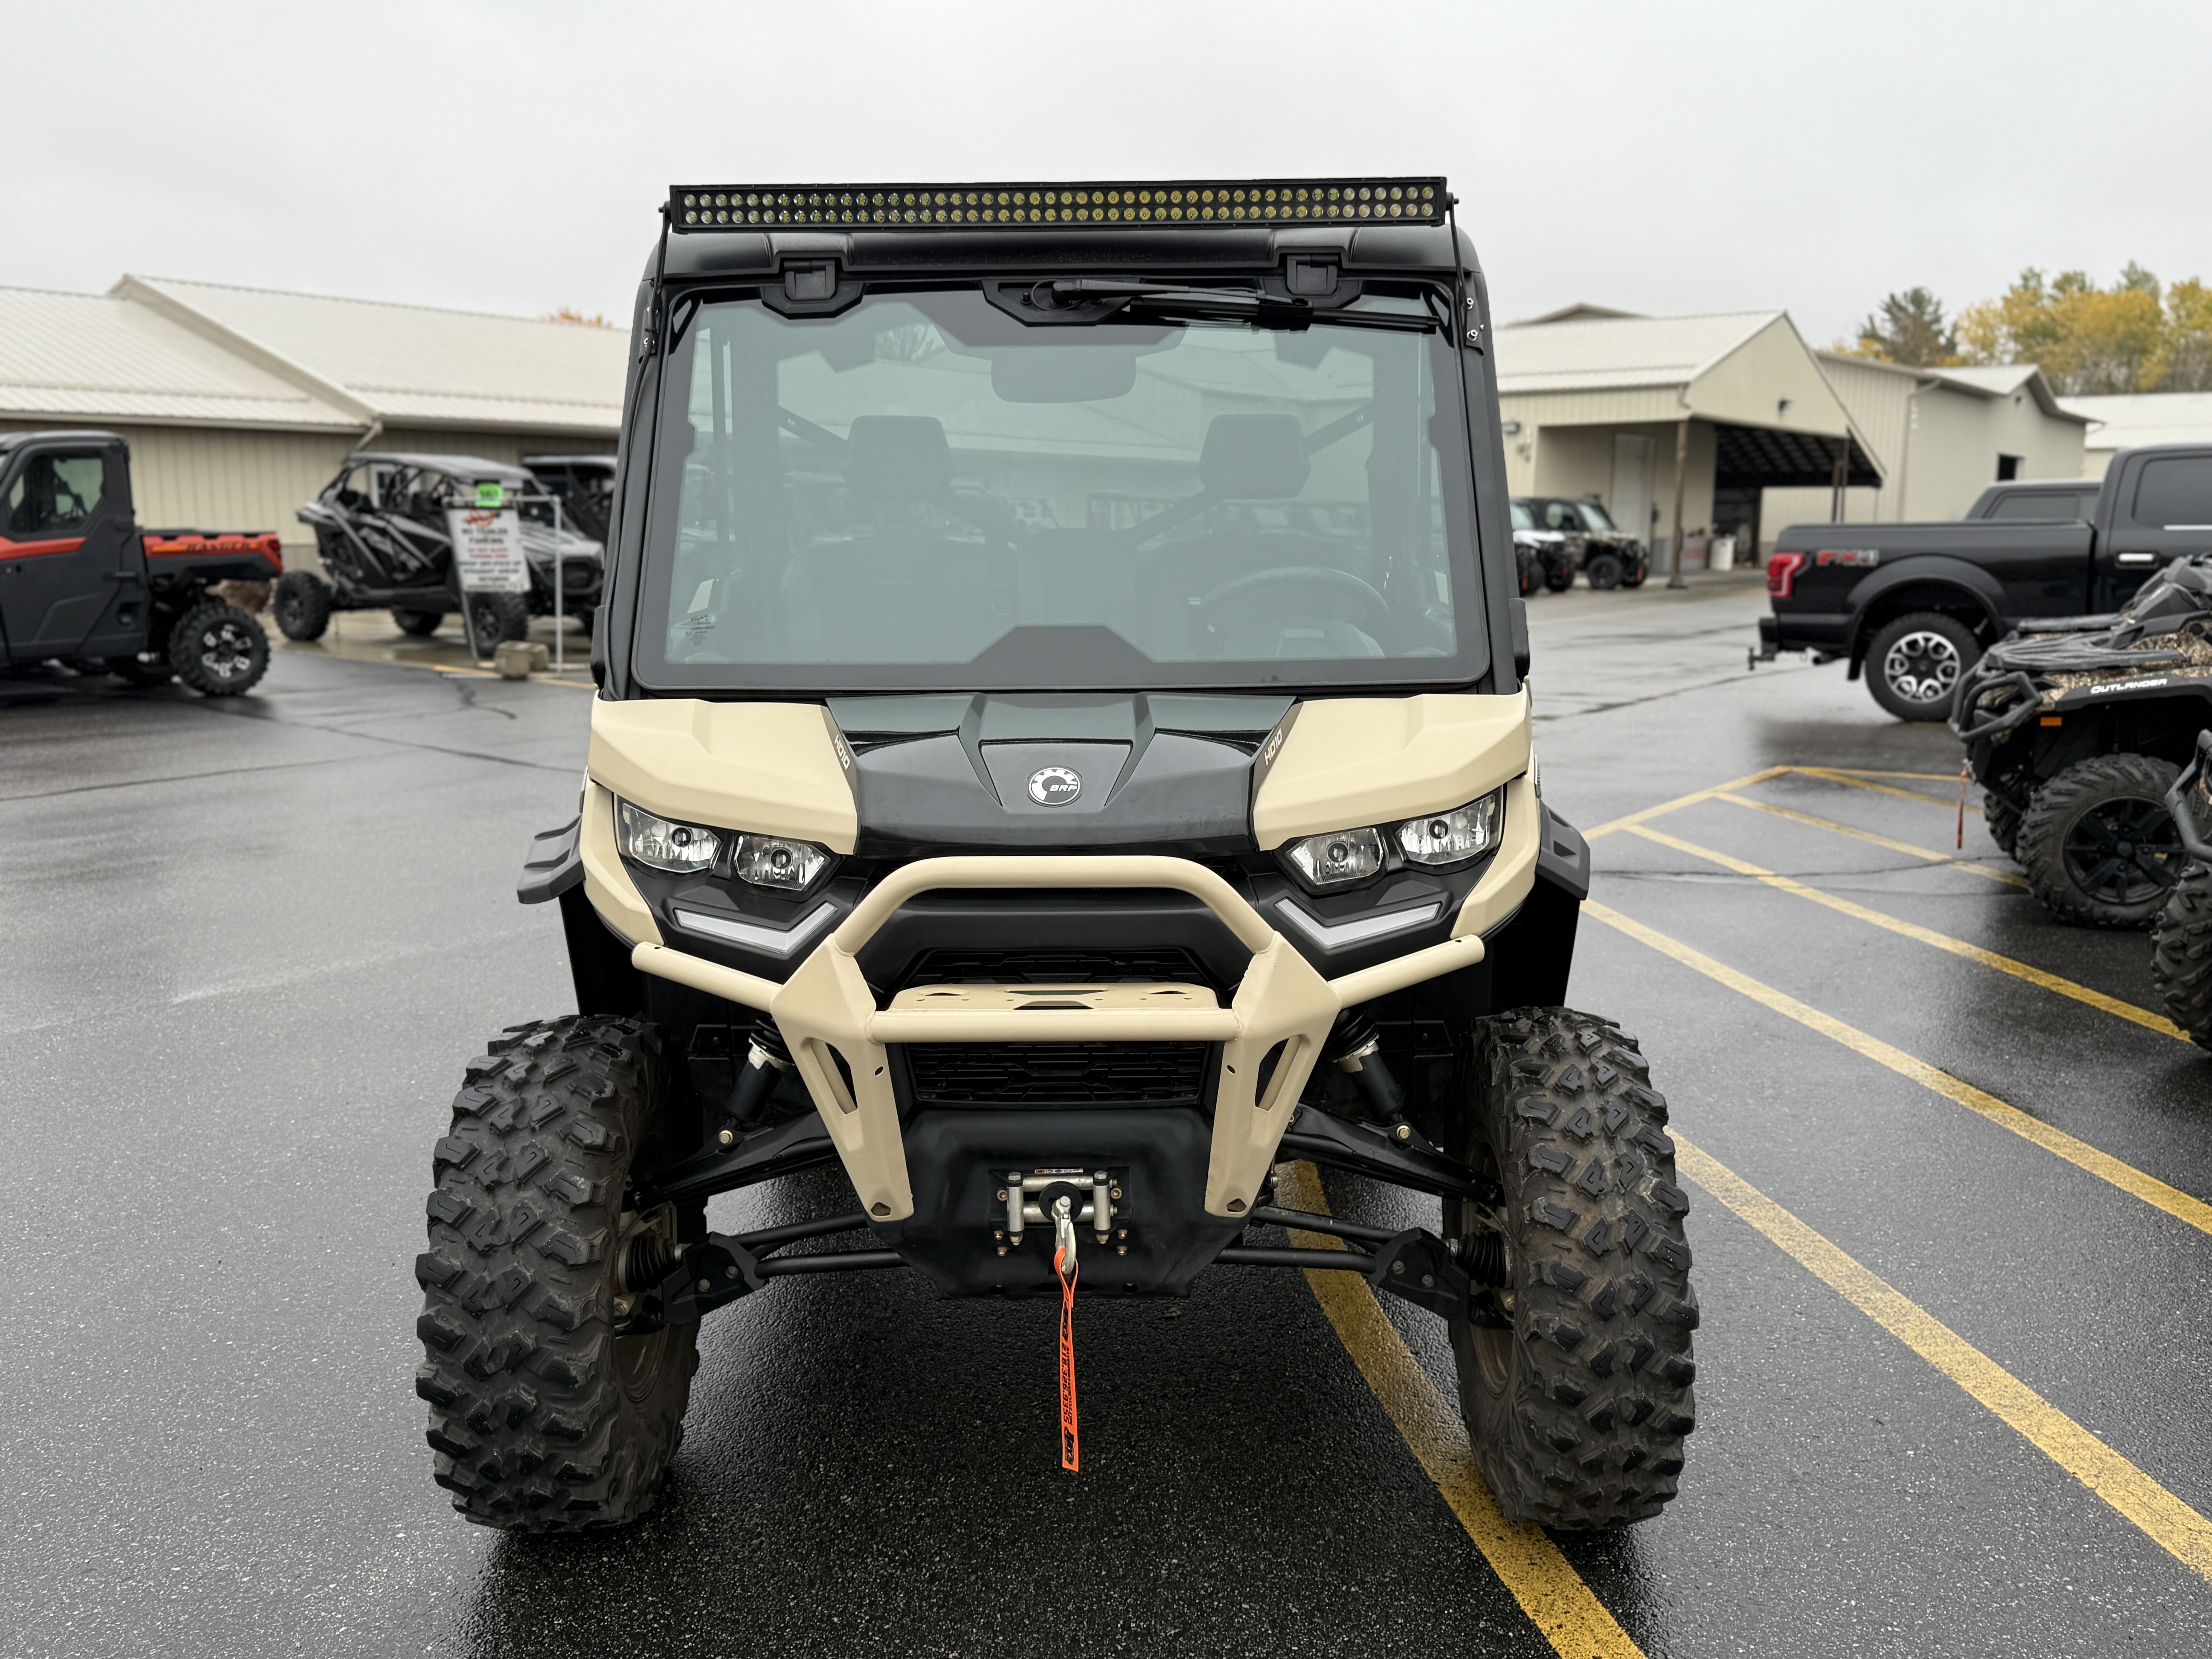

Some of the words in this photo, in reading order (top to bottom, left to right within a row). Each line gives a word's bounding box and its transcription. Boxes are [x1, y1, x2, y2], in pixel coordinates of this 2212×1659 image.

[1817, 549, 1879, 566] FX4
[2090, 679, 2167, 694] OUTLANDER
[834, 734, 850, 770] HD10
[1264, 728, 1283, 766] HD10
